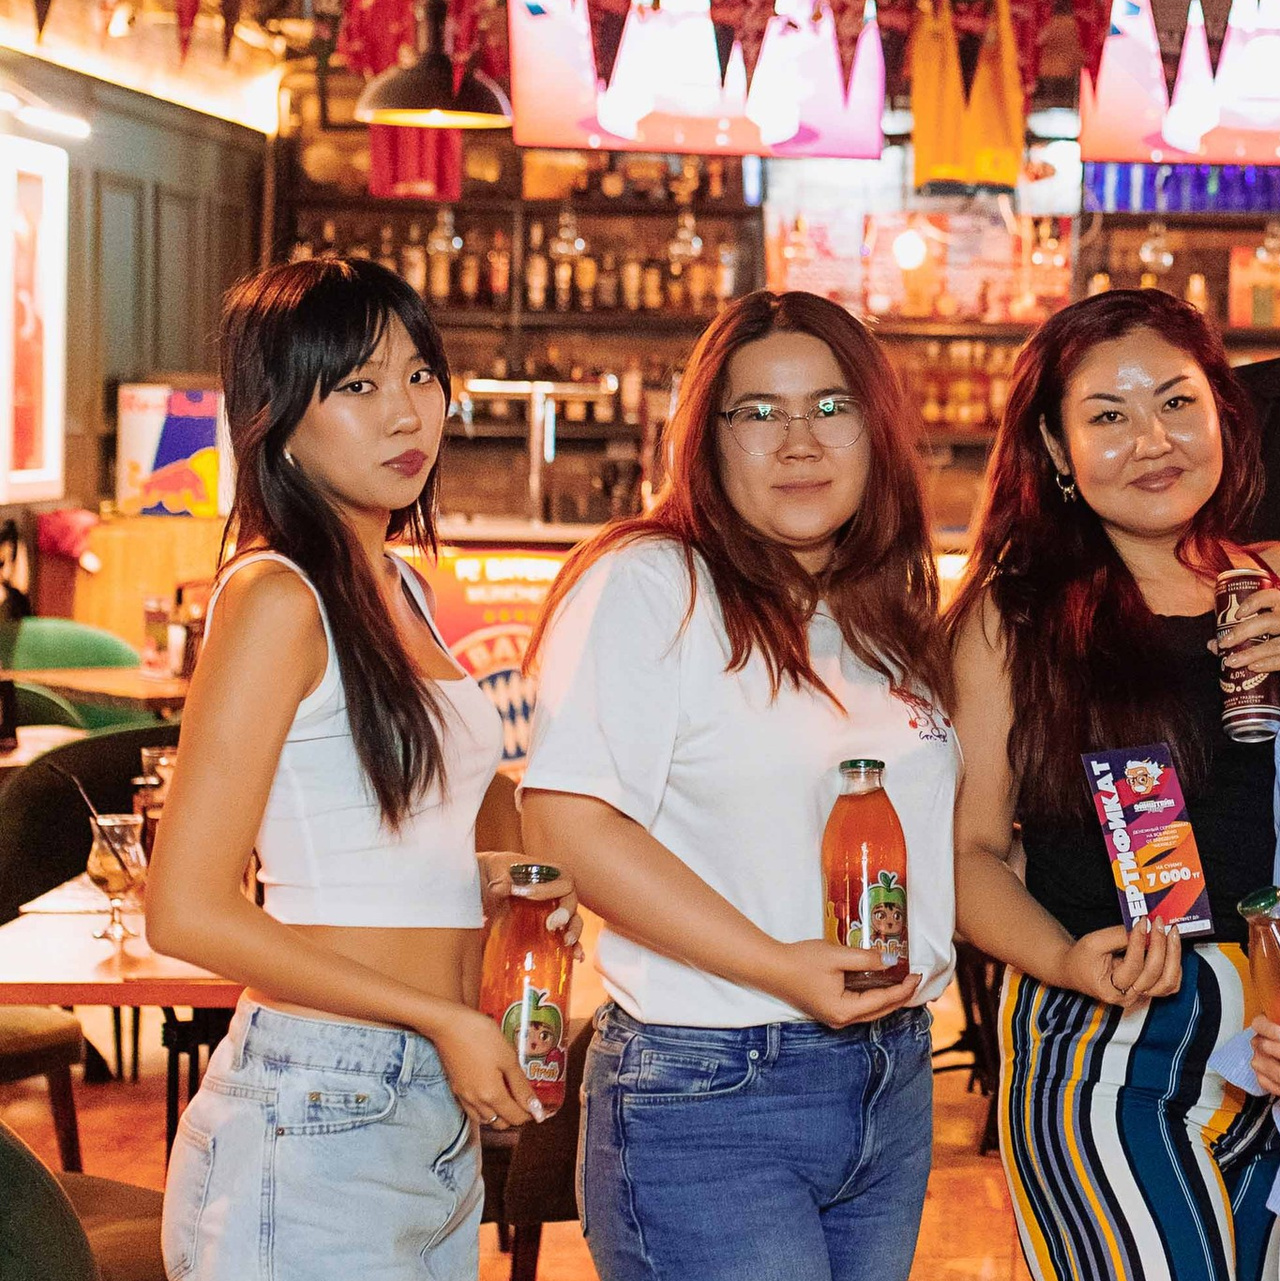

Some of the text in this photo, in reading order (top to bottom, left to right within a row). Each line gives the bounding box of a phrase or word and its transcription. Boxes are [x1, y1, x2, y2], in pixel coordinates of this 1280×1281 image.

[1230, 670, 1246, 680] 4,0%
[1146, 872, 1156, 887] 7
[1159, 866, 1191, 885] 000
